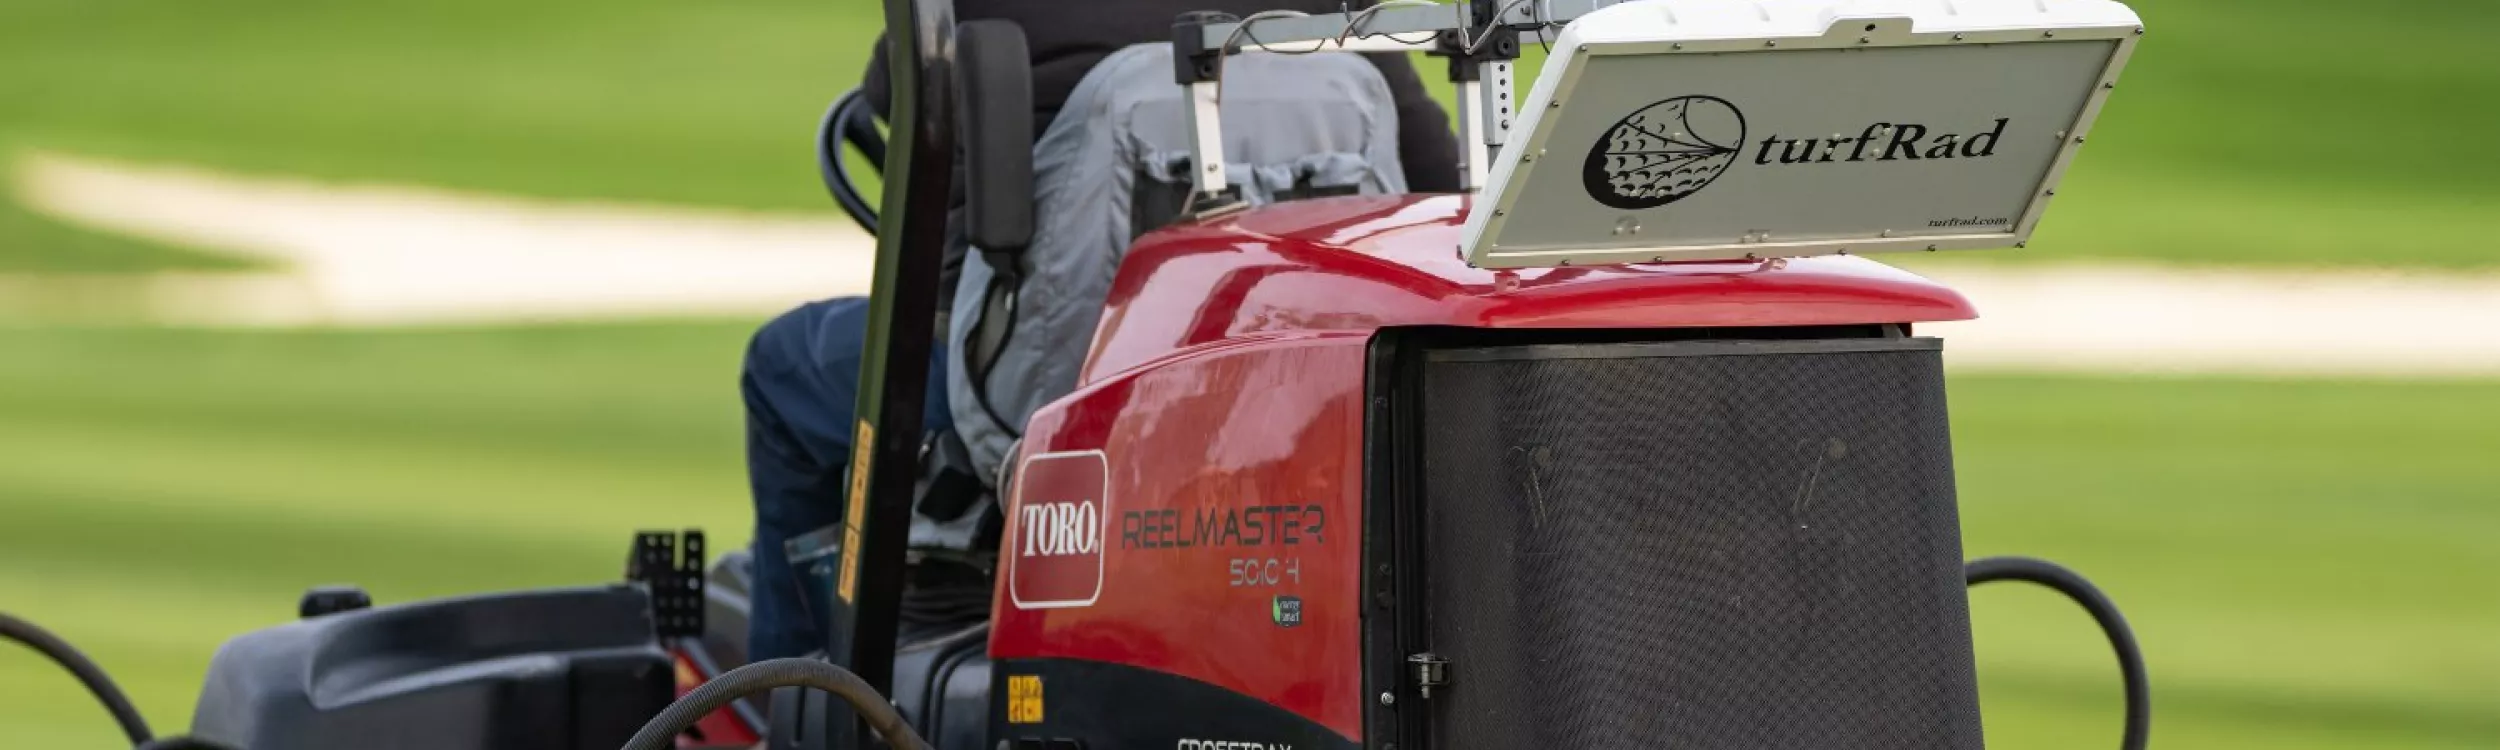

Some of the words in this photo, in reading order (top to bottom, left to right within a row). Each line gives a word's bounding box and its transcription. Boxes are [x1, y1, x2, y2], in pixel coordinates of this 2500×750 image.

[1755, 118, 2009, 165] turfRad
[1928, 216, 2007, 227] turfrad.com
[1022, 500, 1096, 556] TORO
[1122, 505, 1325, 549] REELMASTER
